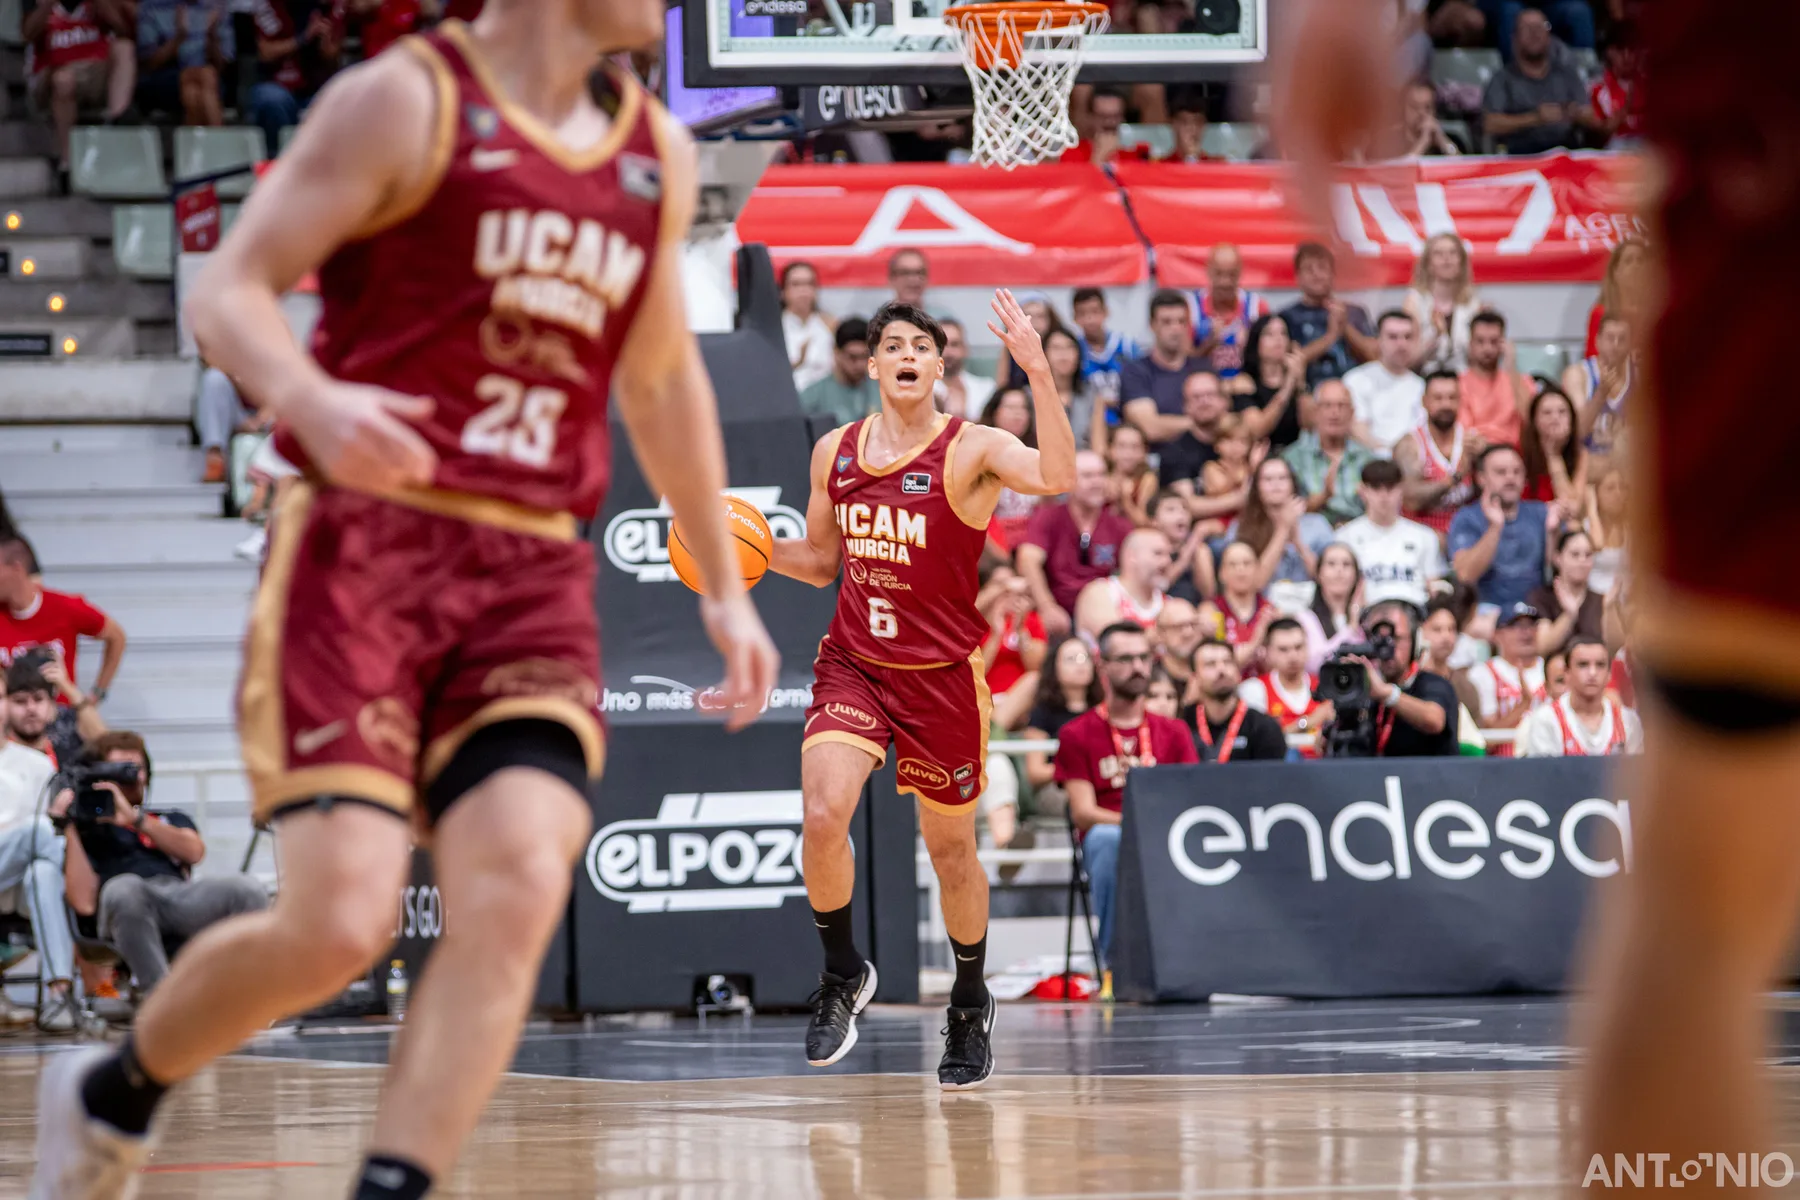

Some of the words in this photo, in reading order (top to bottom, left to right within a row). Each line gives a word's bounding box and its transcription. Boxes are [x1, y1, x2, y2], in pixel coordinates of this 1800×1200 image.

[473, 208, 646, 310] UCAM
[730, 511, 765, 539] endesa
[834, 503, 927, 549] UCAM
[846, 537, 912, 566] MURCIA
[867, 597, 898, 639] 6
[831, 702, 872, 724] Juver
[901, 763, 945, 784] Juver
[1168, 775, 1634, 886] endesa
